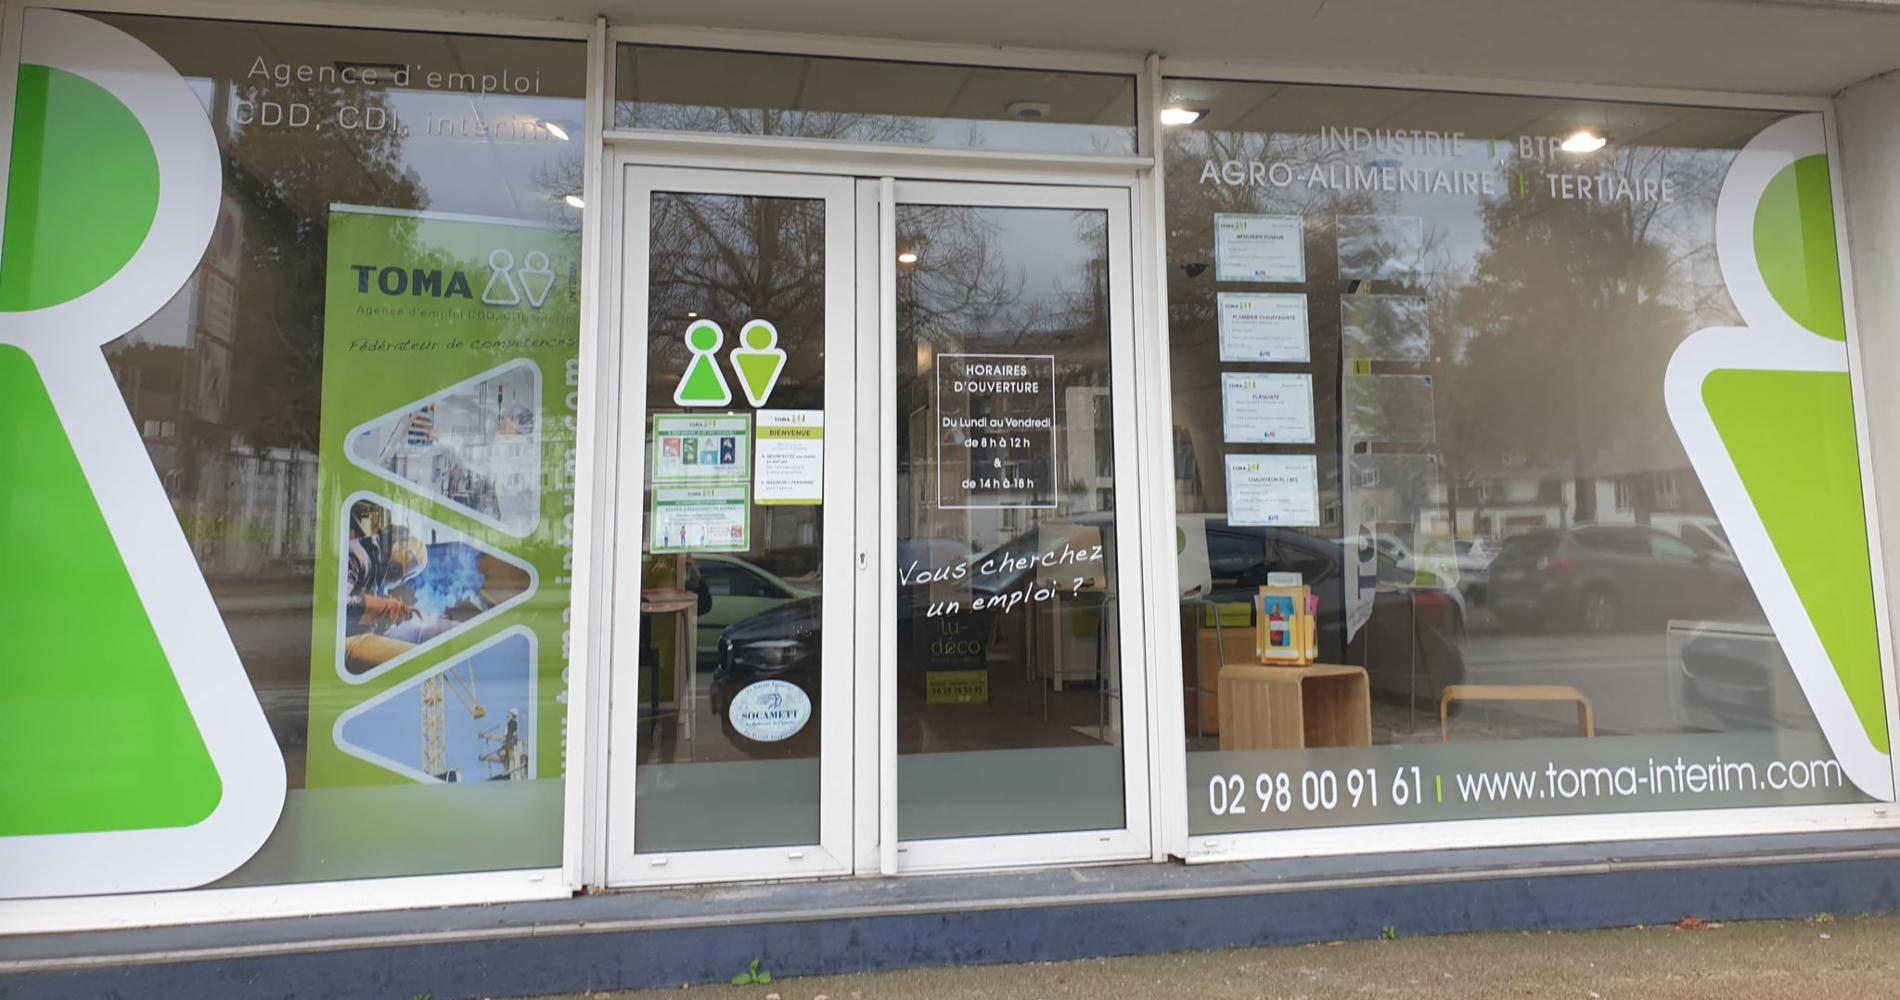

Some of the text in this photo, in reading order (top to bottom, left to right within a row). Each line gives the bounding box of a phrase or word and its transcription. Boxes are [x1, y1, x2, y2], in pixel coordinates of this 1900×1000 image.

[247, 56, 542, 96] Agence d'emploi
[234, 102, 321, 132] CDD,
[338, 105, 409, 137] CDI,
[1320, 125, 1565, 161] INDUSTRIE BTP
[1199, 159, 1674, 201] AGRO-ALIMENTAIRE TERTIAIRE
[351, 264, 473, 299] TOMA
[356, 304, 404, 317] Agence
[349, 337, 577, 352] Fédérateur de compétences
[966, 364, 1027, 376] HORAIRES
[954, 381, 1039, 393] D'OUVERTURE
[942, 417, 1051, 428] Du Lundi au Vendredi
[769, 429, 811, 437] BIENVENUE
[964, 437, 1030, 448] de 8 h à 12 h
[994, 458, 1002, 468] &
[962, 478, 1034, 489] de 14 h à 18 h
[899, 543, 1104, 586] Vous cherchez
[926, 577, 1084, 617] un emploi ?
[1208, 755, 1843, 816] 02 98 00 91 61 www.toma-interim.com
